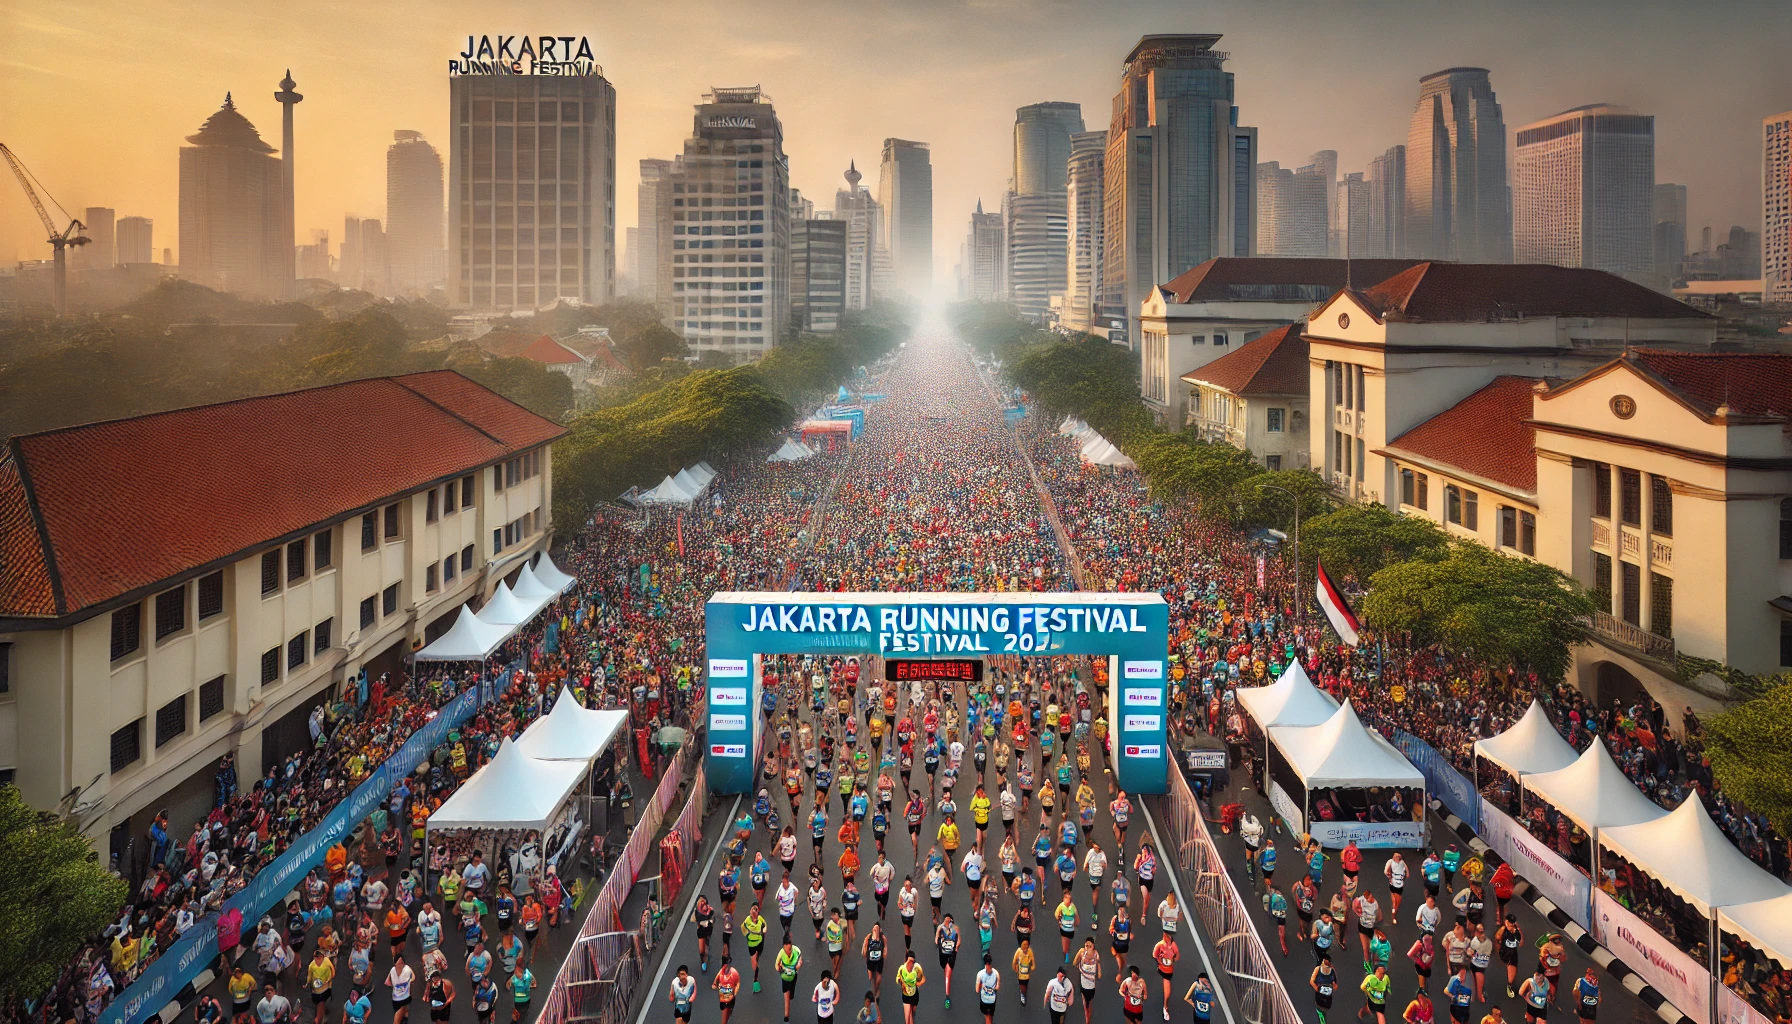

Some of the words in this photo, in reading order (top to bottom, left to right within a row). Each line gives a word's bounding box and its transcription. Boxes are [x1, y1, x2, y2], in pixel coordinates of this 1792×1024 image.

[460, 35, 594, 61] JAKARTA
[742, 605, 872, 633] JAKARTA
[880, 605, 1010, 633] RUNNING
[1018, 607, 1147, 633] FESTIVAL
[880, 633, 990, 653] FESTIVAL
